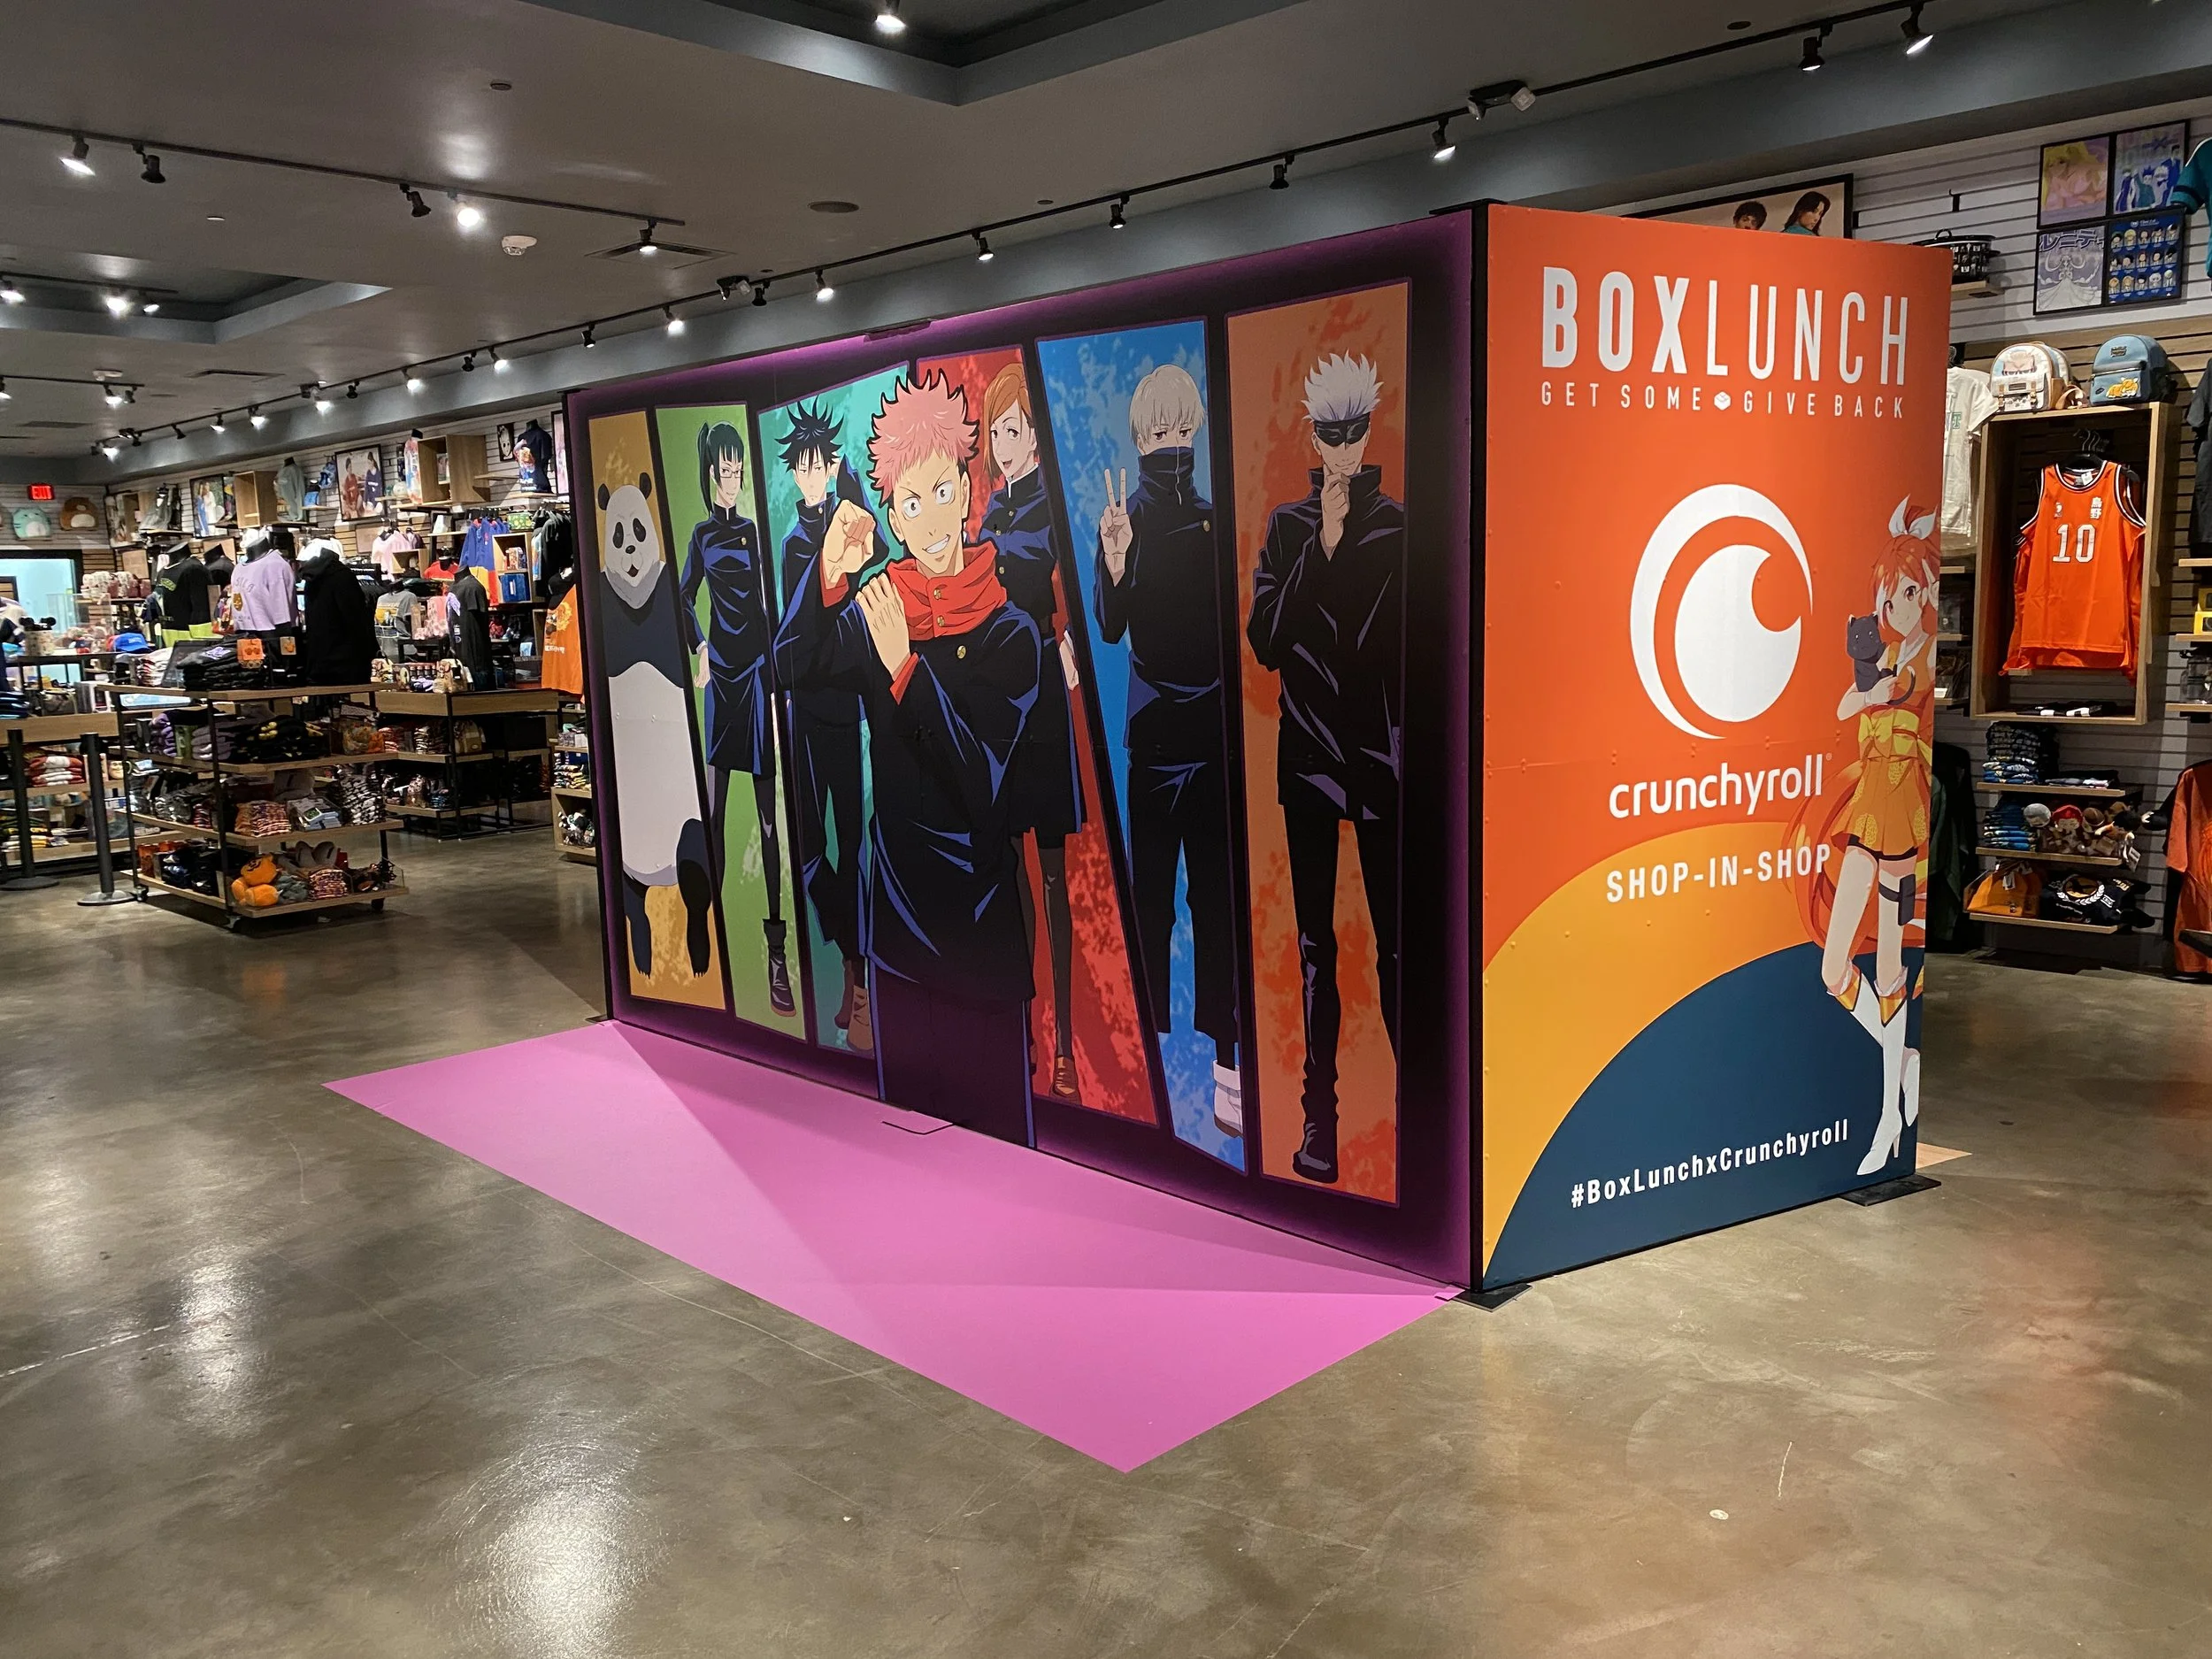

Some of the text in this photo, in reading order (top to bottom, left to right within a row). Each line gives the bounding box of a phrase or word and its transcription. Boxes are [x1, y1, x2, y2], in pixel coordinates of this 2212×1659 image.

[1541, 265, 1909, 386] BOXLUNCH
[1540, 380, 1903, 419] GET SOME GIVE BACK
[2053, 524, 2096, 563] 10
[1608, 754, 1824, 818] crunchyroll
[1605, 843, 1832, 903] SHOP-IN-SHOP
[1571, 1118, 1849, 1209] #BoxLunchxCrunchyroll
